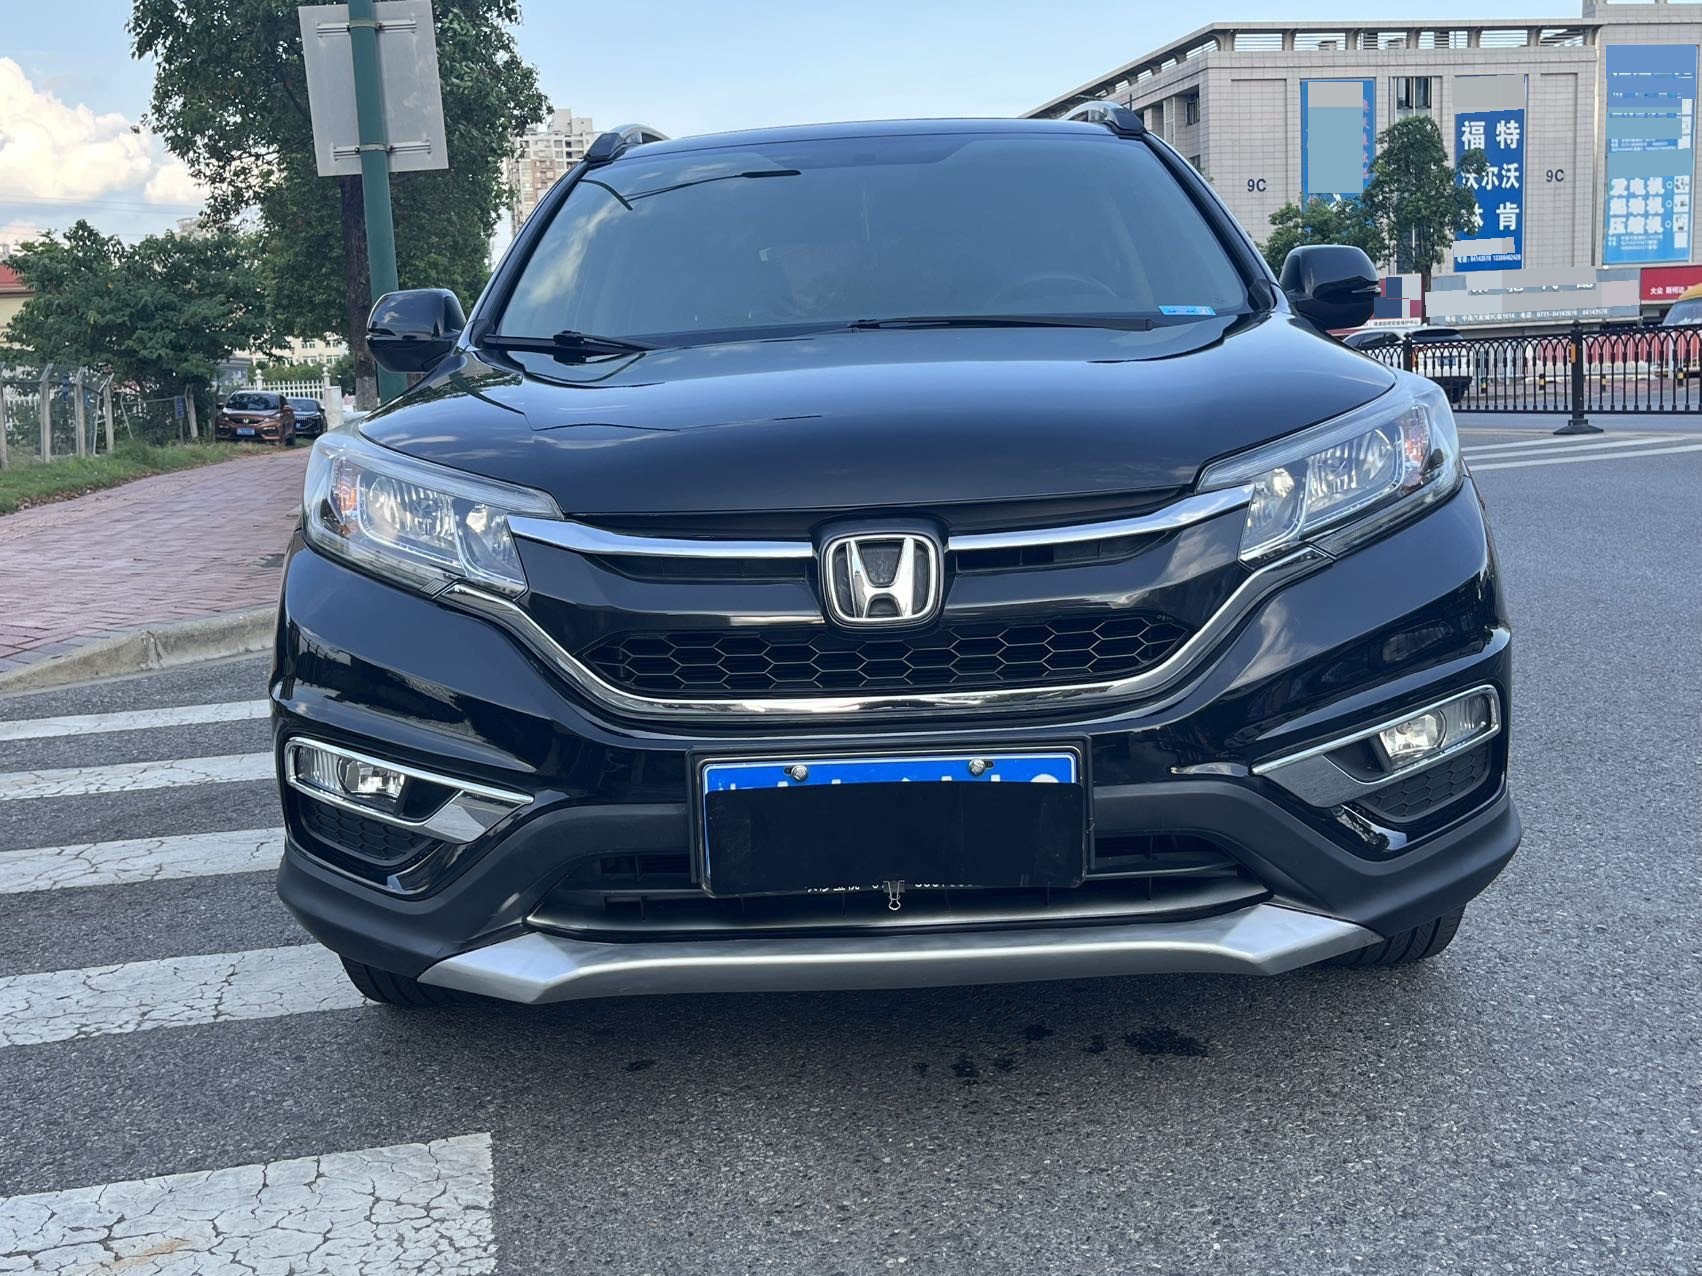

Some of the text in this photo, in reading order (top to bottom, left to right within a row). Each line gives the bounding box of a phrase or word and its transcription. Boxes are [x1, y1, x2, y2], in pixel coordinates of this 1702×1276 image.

[1461, 120, 1520, 150] 福特
[1546, 169, 1565, 182] 9C
[1247, 178, 1266, 192] 9C
